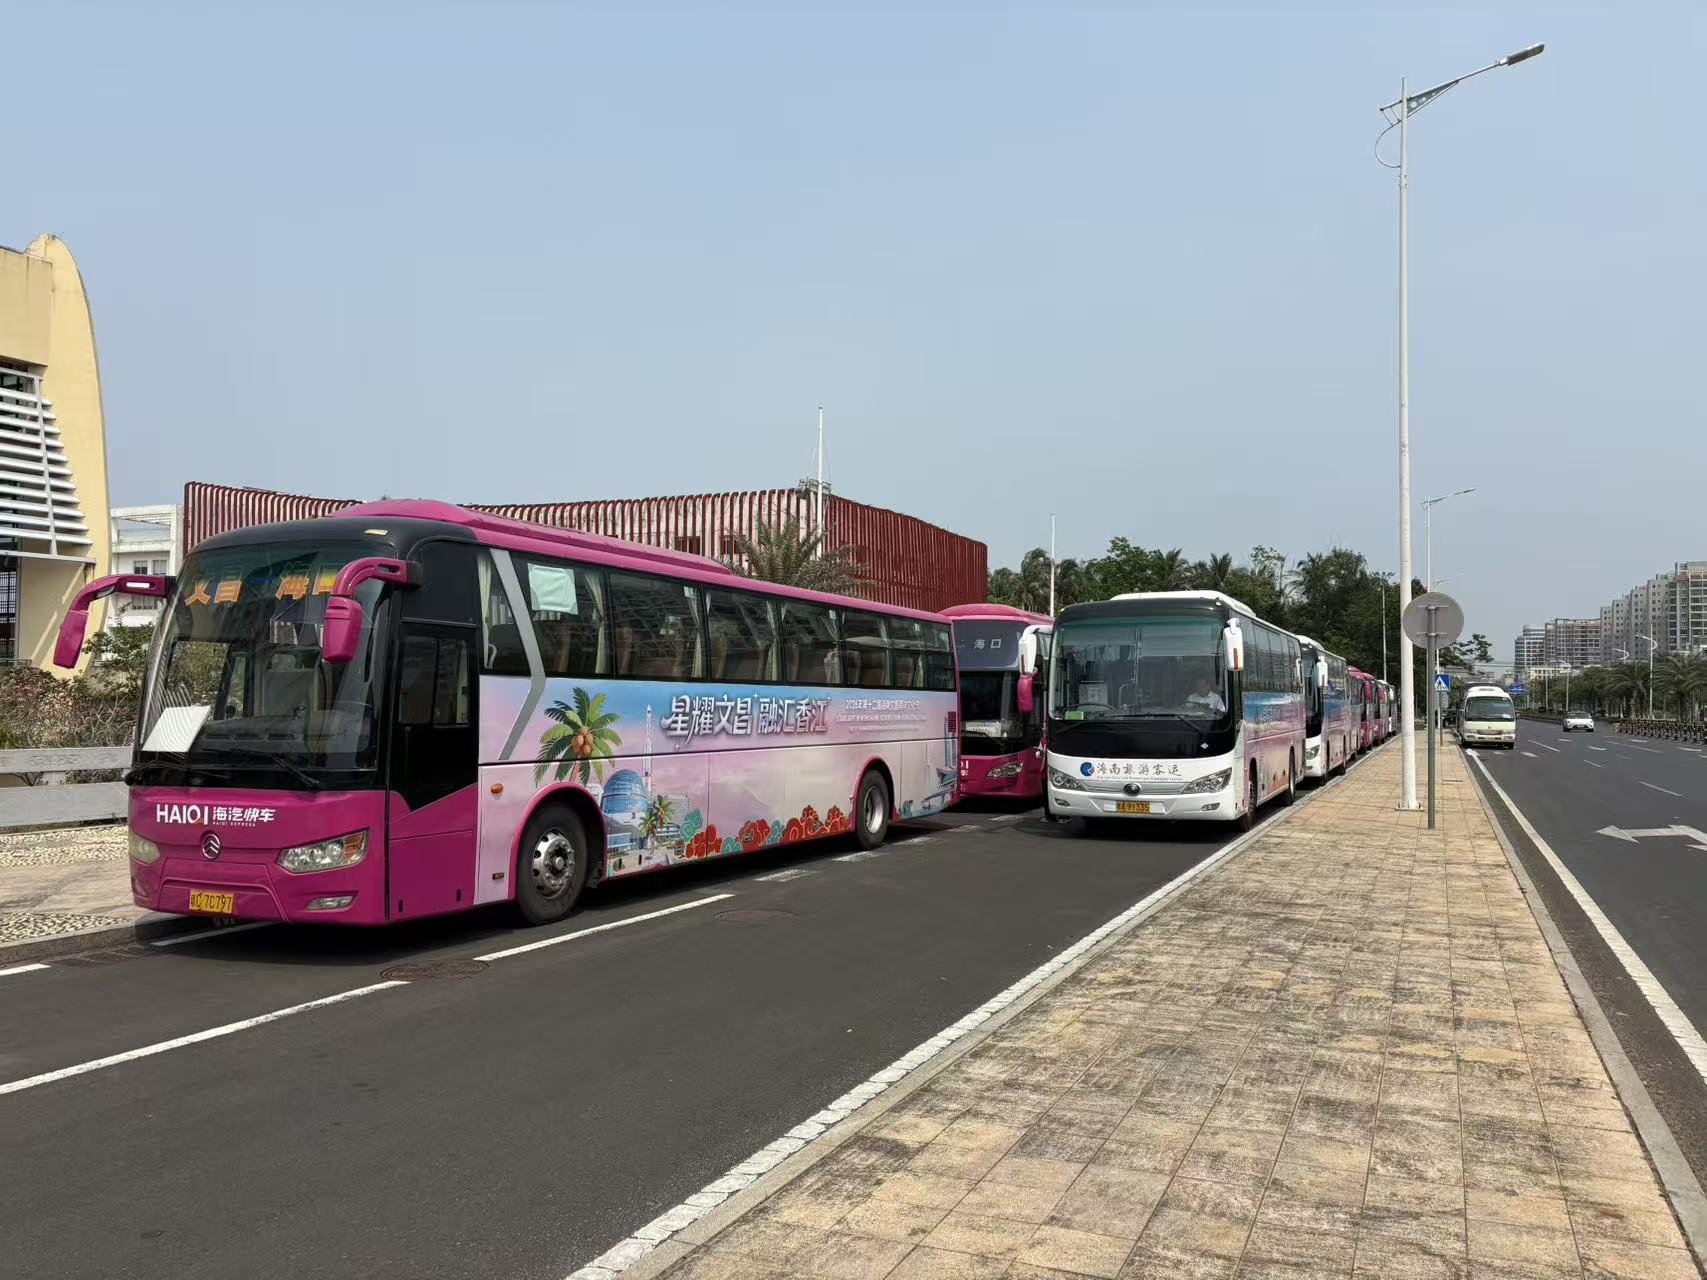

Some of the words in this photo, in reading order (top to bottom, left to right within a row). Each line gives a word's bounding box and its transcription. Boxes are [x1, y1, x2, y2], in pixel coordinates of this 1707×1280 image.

[973, 638, 1002, 650] 海口
[661, 695, 752, 743] 星耀文昌
[757, 696, 829, 734] 融汇香江
[1096, 762, 1182, 777] 海南旅游客运
[212, 806, 276, 823] 海汽快车
